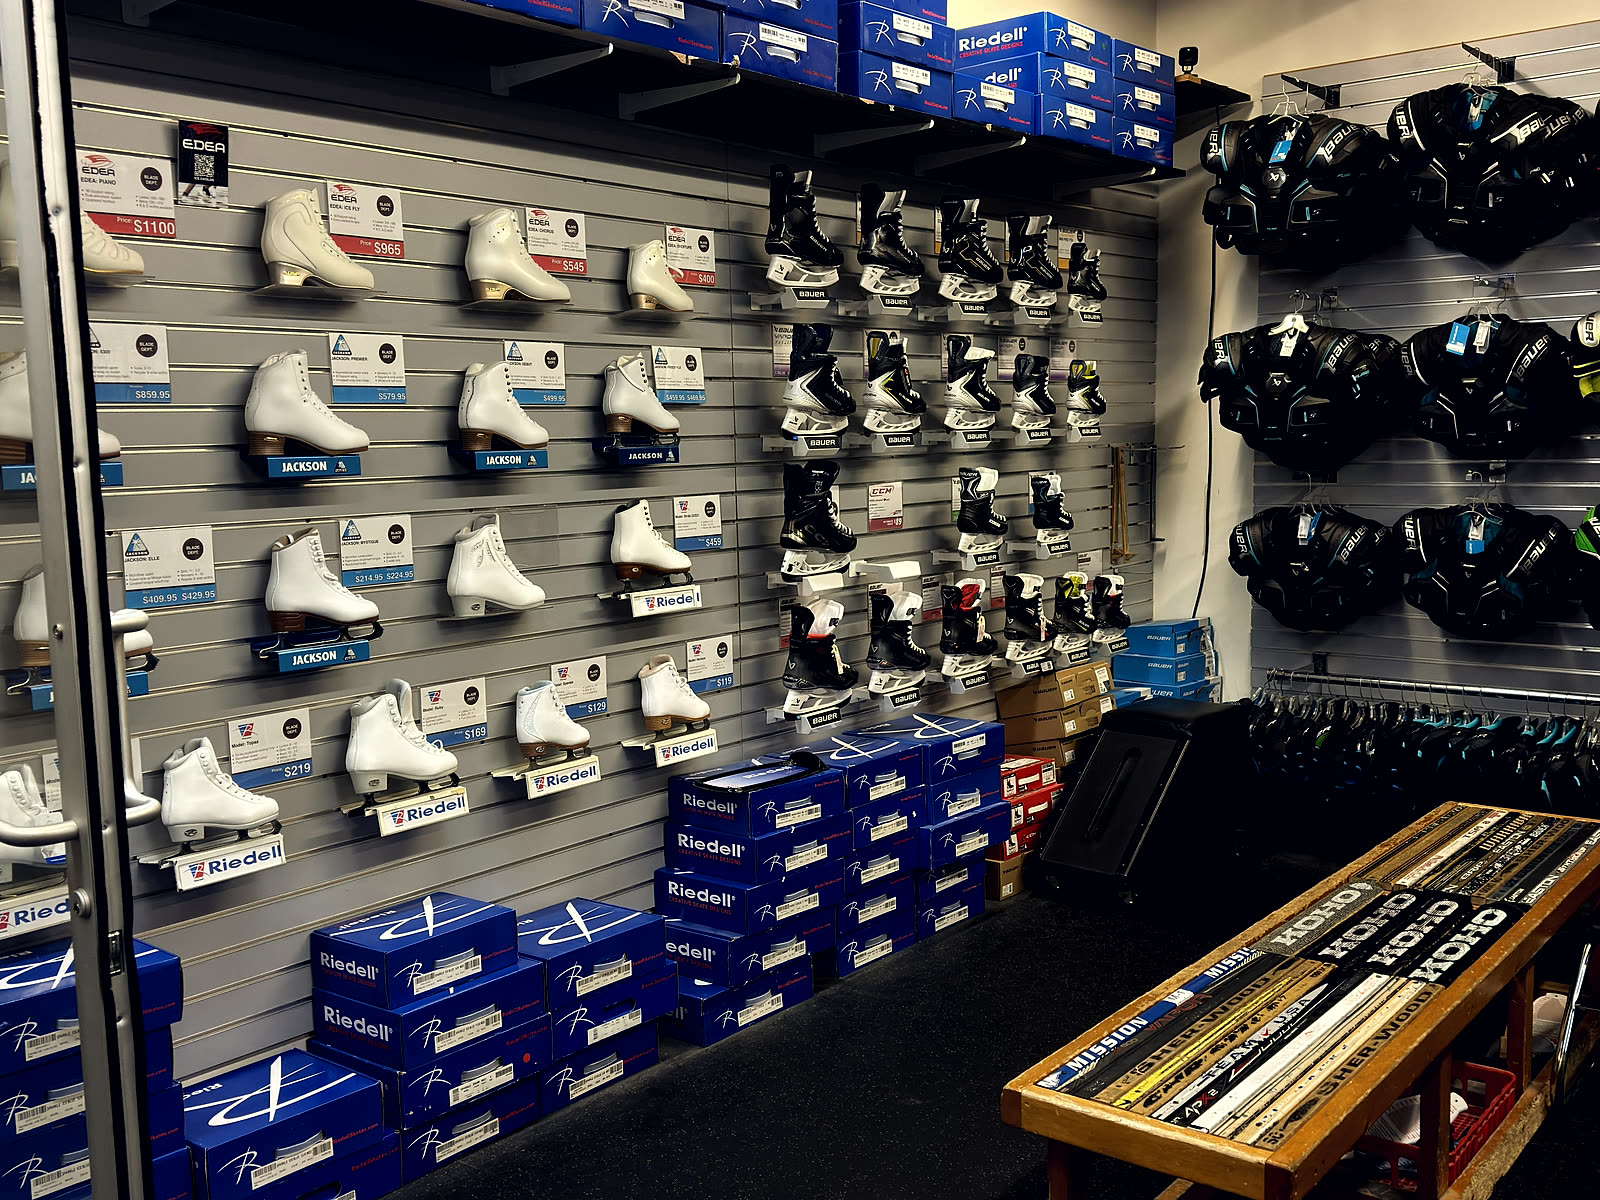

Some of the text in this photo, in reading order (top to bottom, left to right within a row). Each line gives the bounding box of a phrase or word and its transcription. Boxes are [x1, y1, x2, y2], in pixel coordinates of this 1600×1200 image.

[959, 26, 1023, 52] Riedell
[984, 67, 1018, 84] dell
[1396, 104, 1411, 138] UER
[182, 138, 225, 154] EDEA
[1324, 124, 1360, 164] BAUE
[82, 166, 115, 177] EDEA
[80, 176, 98, 184] EDEA:
[331, 194, 357, 204] EDEA
[134, 219, 175, 235] $1100
[529, 219, 550, 227] EDEA
[374, 242, 401, 256] $965
[563, 260, 585, 272] $545
[698, 273, 715, 284] $400
[799, 290, 825, 298] BAUER
[1516, 335, 1551, 378] BAUER
[135, 390, 170, 399] $859.95
[378, 392, 406, 400] $579.95
[486, 455, 522, 465] JACKSON
[628, 452, 663, 460] JACKSON
[281, 461, 328, 473] JACKSON
[705, 537, 722, 547] $459
[1340, 525, 1368, 563] BAUER
[977, 554, 997, 562] BAUER
[355, 570, 414, 583] $214.95 $224.95
[142, 590, 216, 604] $409.95 $429.95
[292, 650, 337, 666] JACKSON
[1026, 663, 1040, 671] BAU
[717, 676, 732, 687] $119
[965, 675, 986, 686] BAUER
[895, 693, 918, 703] BAUER
[587, 701, 606, 713] $129
[812, 712, 838, 725] BAUER
[464, 726, 486, 740] $169
[671, 737, 714, 757] Riedell
[284, 762, 311, 778] $219
[546, 765, 597, 787] Riedell
[406, 796, 465, 822] Riedell
[683, 793, 735, 814] Riedell
[677, 833, 741, 858] Riedell
[207, 845, 282, 875] Riedell
[668, 880, 731, 908] Riedell
[1524, 874, 1559, 904] EASTON
[14, 899, 71, 926] Ried
[1271, 887, 1362, 947] KOHO
[1319, 892, 1417, 959] KOHO
[1367, 899, 1459, 966] KOHO
[666, 941, 712, 962] edell
[1408, 908, 1508, 982] KOHO
[320, 951, 376, 980] Riedell
[1273, 998, 1311, 1024] USA
[323, 1005, 389, 1042] Riedell
[1067, 1016, 1149, 1072] MISSION
[1317, 989, 1434, 1097] SHER-WOOD
